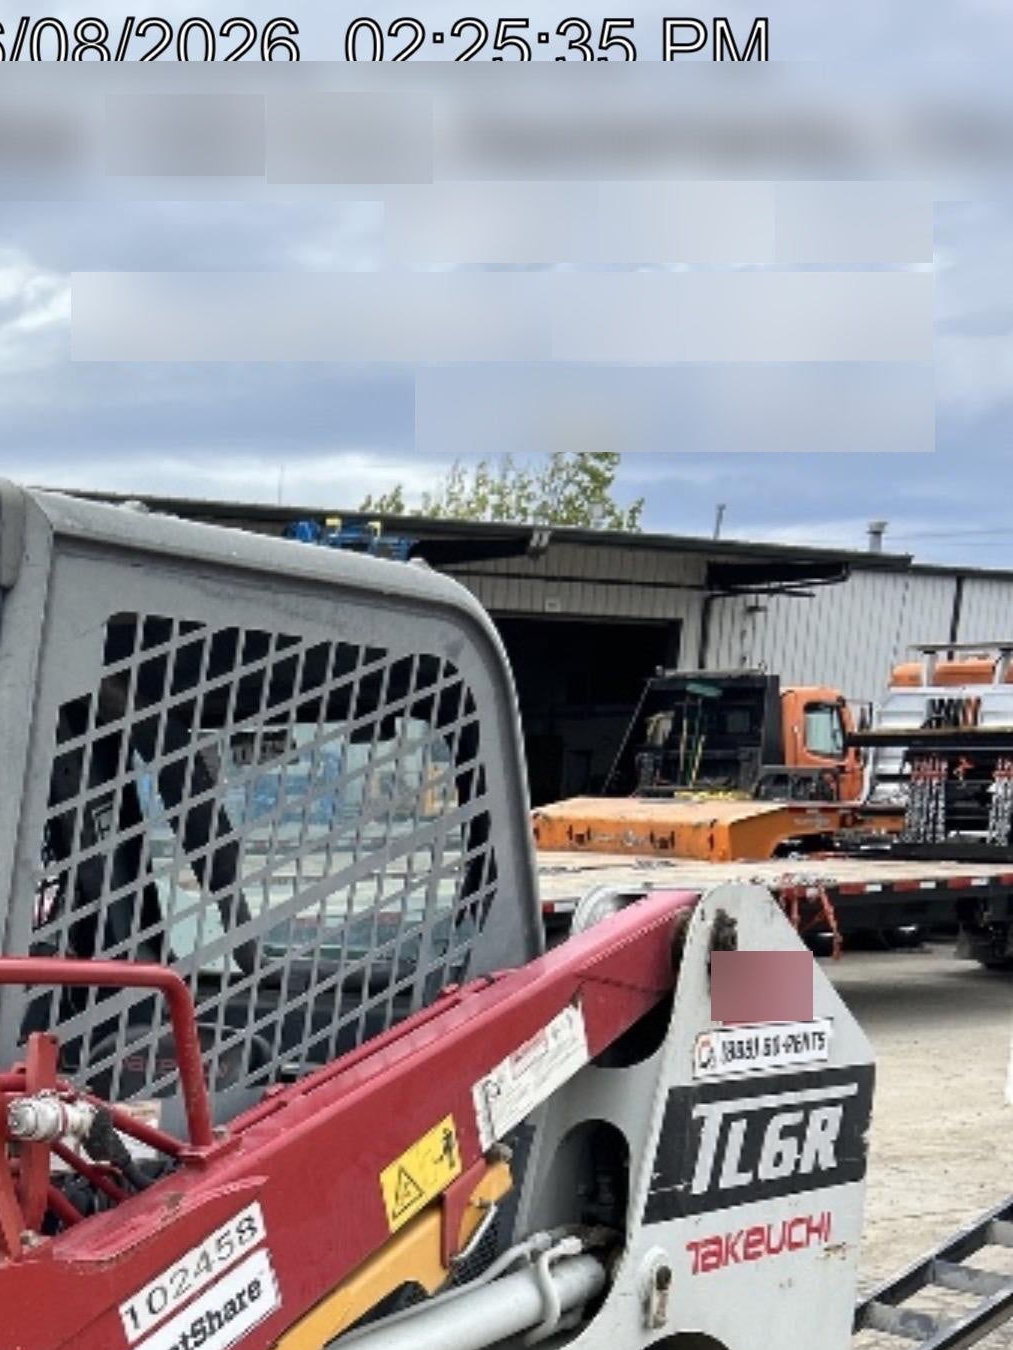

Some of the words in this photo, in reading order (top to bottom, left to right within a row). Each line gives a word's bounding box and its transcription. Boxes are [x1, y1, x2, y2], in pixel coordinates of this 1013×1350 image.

[691, 1083, 859, 1194] TL6R
[124, 1213, 258, 1330] 102458
[686, 1211, 831, 1275] TAKEUCHI
